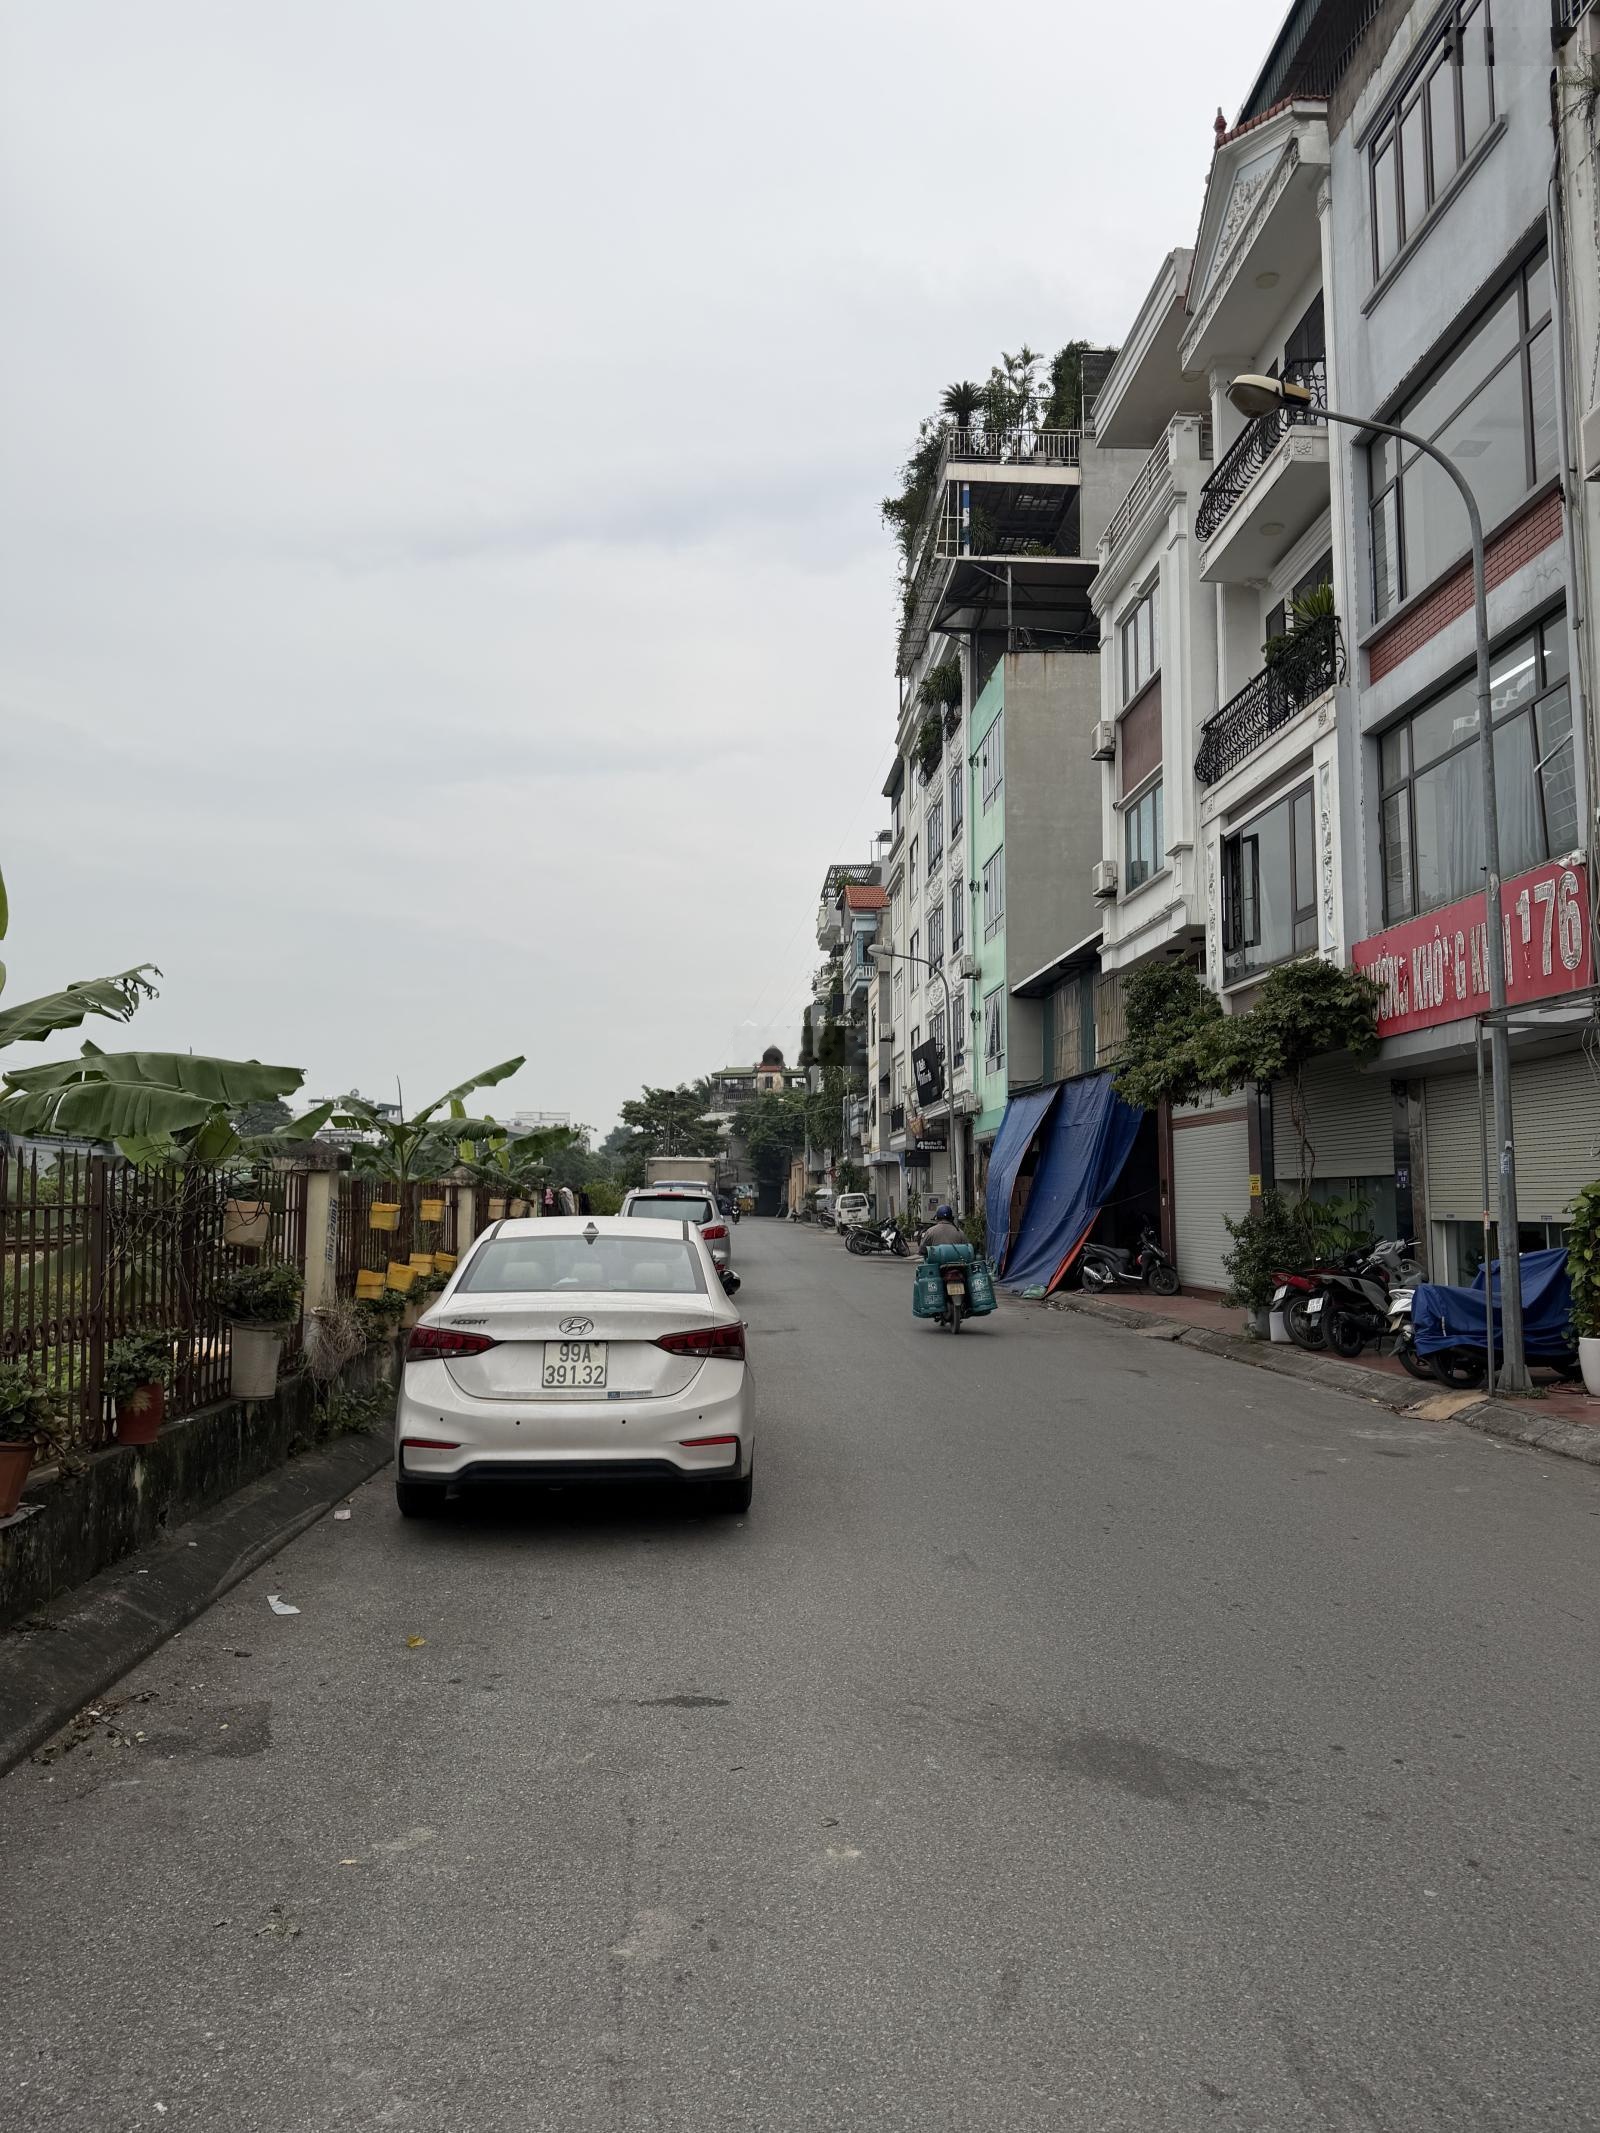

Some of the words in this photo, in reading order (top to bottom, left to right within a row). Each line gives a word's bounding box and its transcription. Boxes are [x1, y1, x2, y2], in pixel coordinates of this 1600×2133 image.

[1515, 871, 1582, 976] 176
[559, 1342, 592, 1363] 99A
[544, 1364, 605, 1385] 391.32
